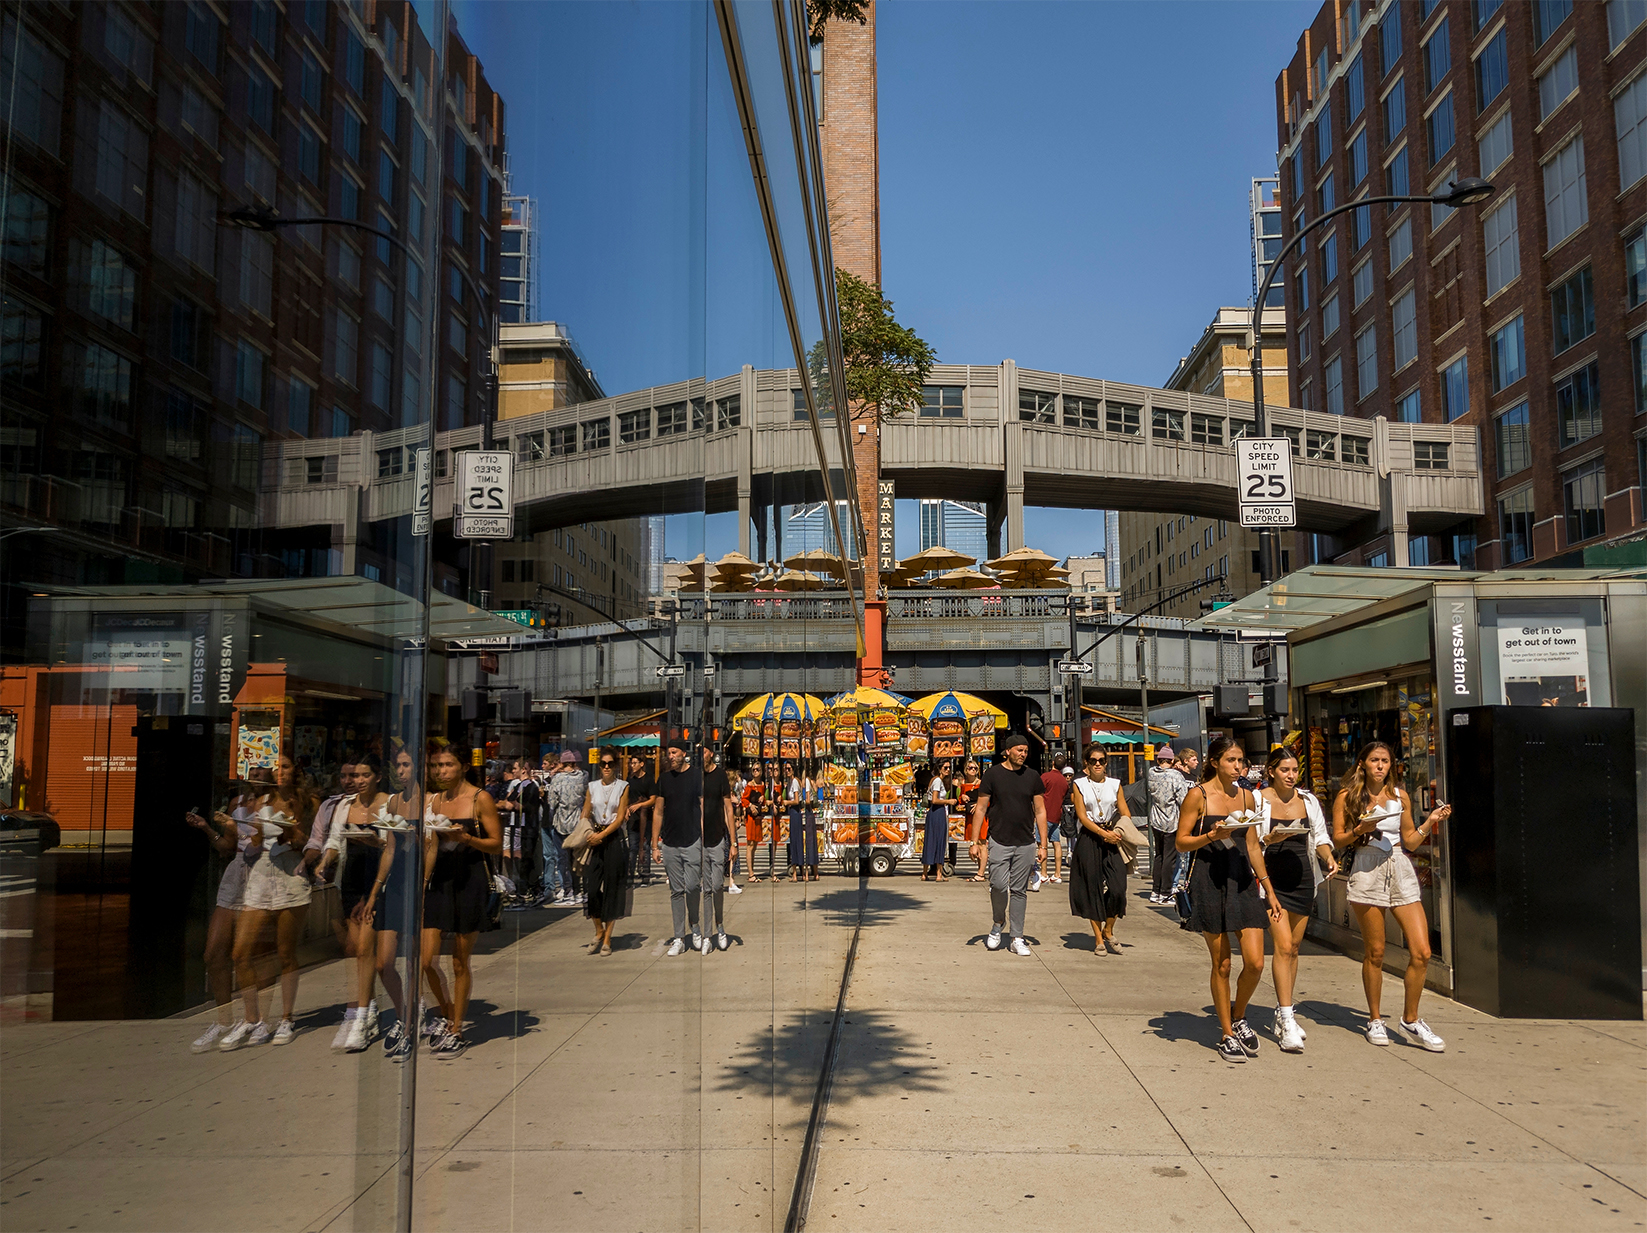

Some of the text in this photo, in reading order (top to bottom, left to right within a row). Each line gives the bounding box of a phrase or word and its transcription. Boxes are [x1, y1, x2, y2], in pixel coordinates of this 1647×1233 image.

[1252, 442, 1274, 450] CITY
[1246, 474, 1286, 497] 25
[879, 482, 893, 568] MARKET
[1245, 515, 1289, 523] ENFORCED
[1505, 639, 1522, 648] get
[1542, 637, 1552, 645] of
[1522, 627, 1539, 635] Get
[192, 613, 209, 704] Newsstand
[219, 614, 236, 704] Newsstand
[1451, 602, 1470, 695] Newsstand
